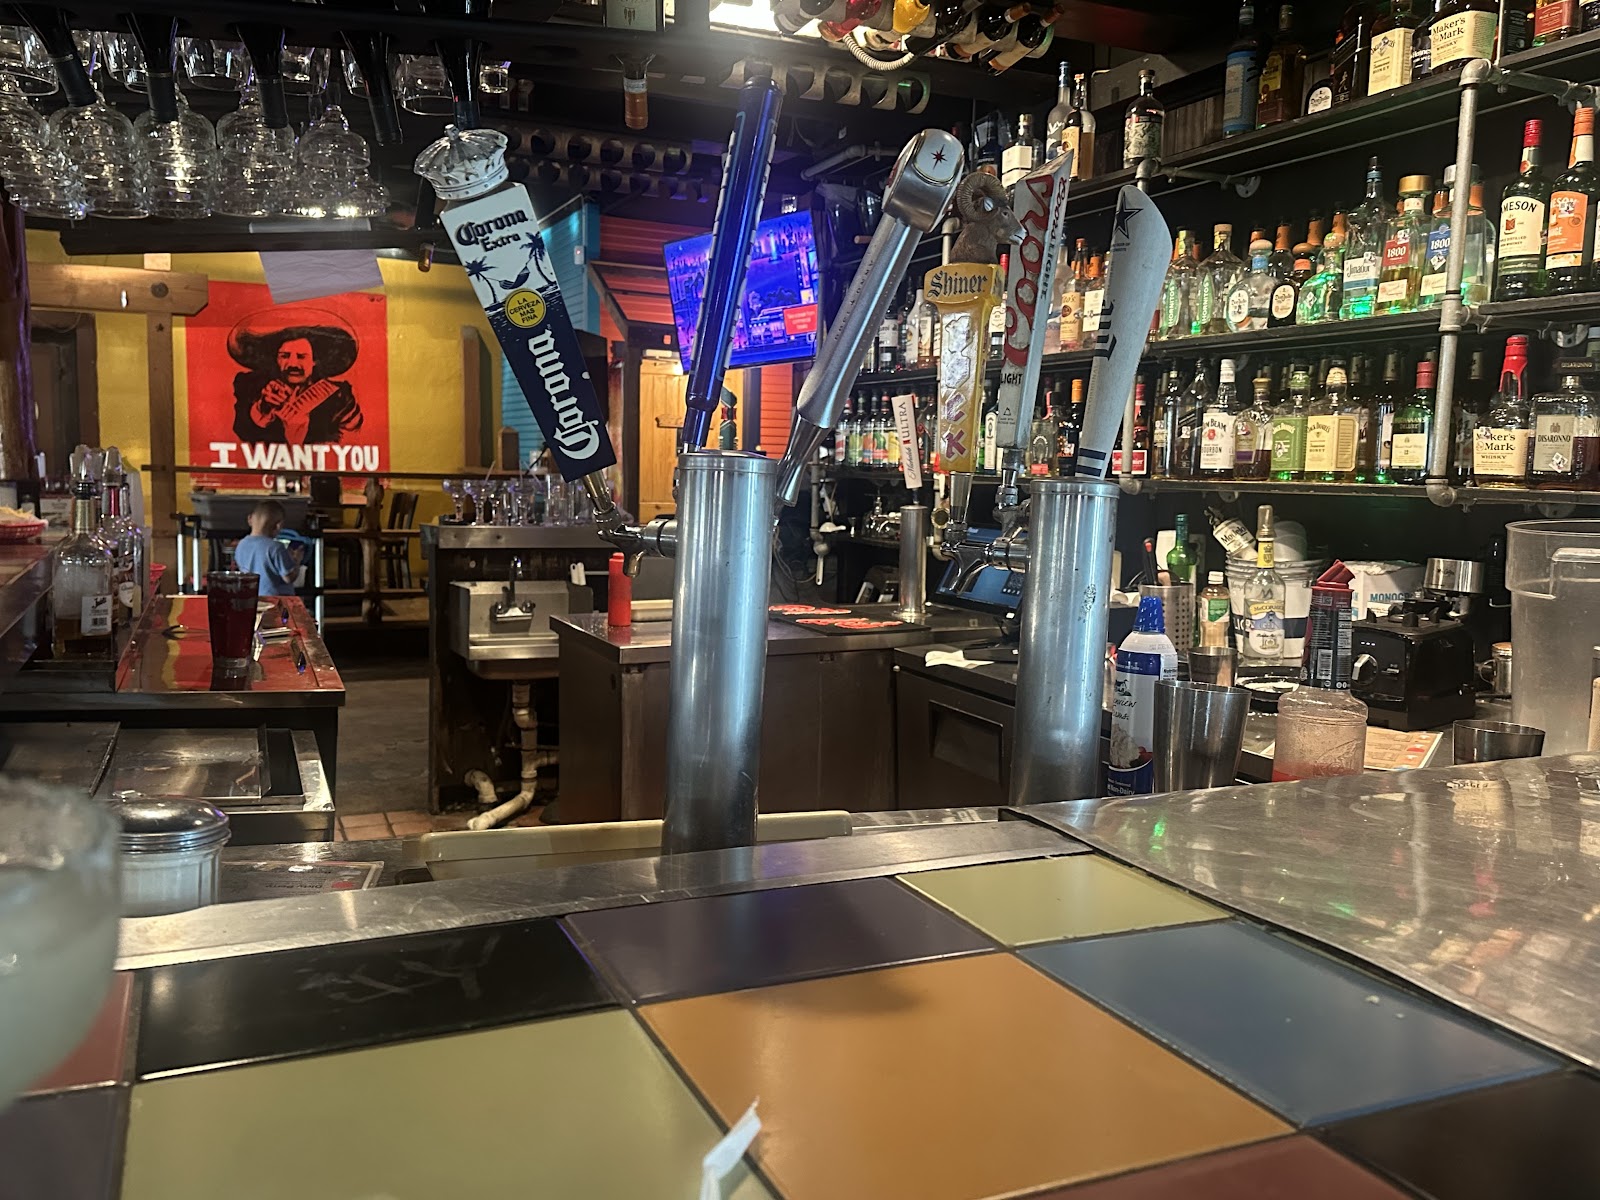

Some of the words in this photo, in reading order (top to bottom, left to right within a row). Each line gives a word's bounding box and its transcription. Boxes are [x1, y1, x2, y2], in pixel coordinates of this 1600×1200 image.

[1432, 17, 1465, 36] Maker's
[1439, 27, 1465, 42] Mark
[1503, 201, 1537, 213] MESON
[455, 209, 529, 247] Corona
[479, 233, 521, 252] Extra
[1430, 237, 1450, 250] 1800
[1387, 245, 1407, 258] 1800
[1041, 243, 1055, 300] LIGHT
[927, 270, 988, 298] Shiner
[509, 299, 542, 315] CERVEZA
[516, 297, 529, 305] LA
[1167, 286, 1175, 327] HORNITOS
[1202, 281, 1210, 325] HORNITOS
[521, 314, 539, 324] FINA
[1000, 373, 1023, 385] LIGHT
[528, 328, 600, 460] Corona
[897, 401, 910, 438] ULTRA
[1210, 418, 1227, 432] BEAM
[1476, 433, 1516, 442] Mker's
[1537, 434, 1571, 444] DISARONNO
[1484, 442, 1515, 451] Mark
[209, 441, 237, 468] I
[240, 442, 330, 471] WANT
[332, 445, 379, 472] YOU
[903, 446, 916, 481] Michelob
[1220, 524, 1247, 544] Modelo
